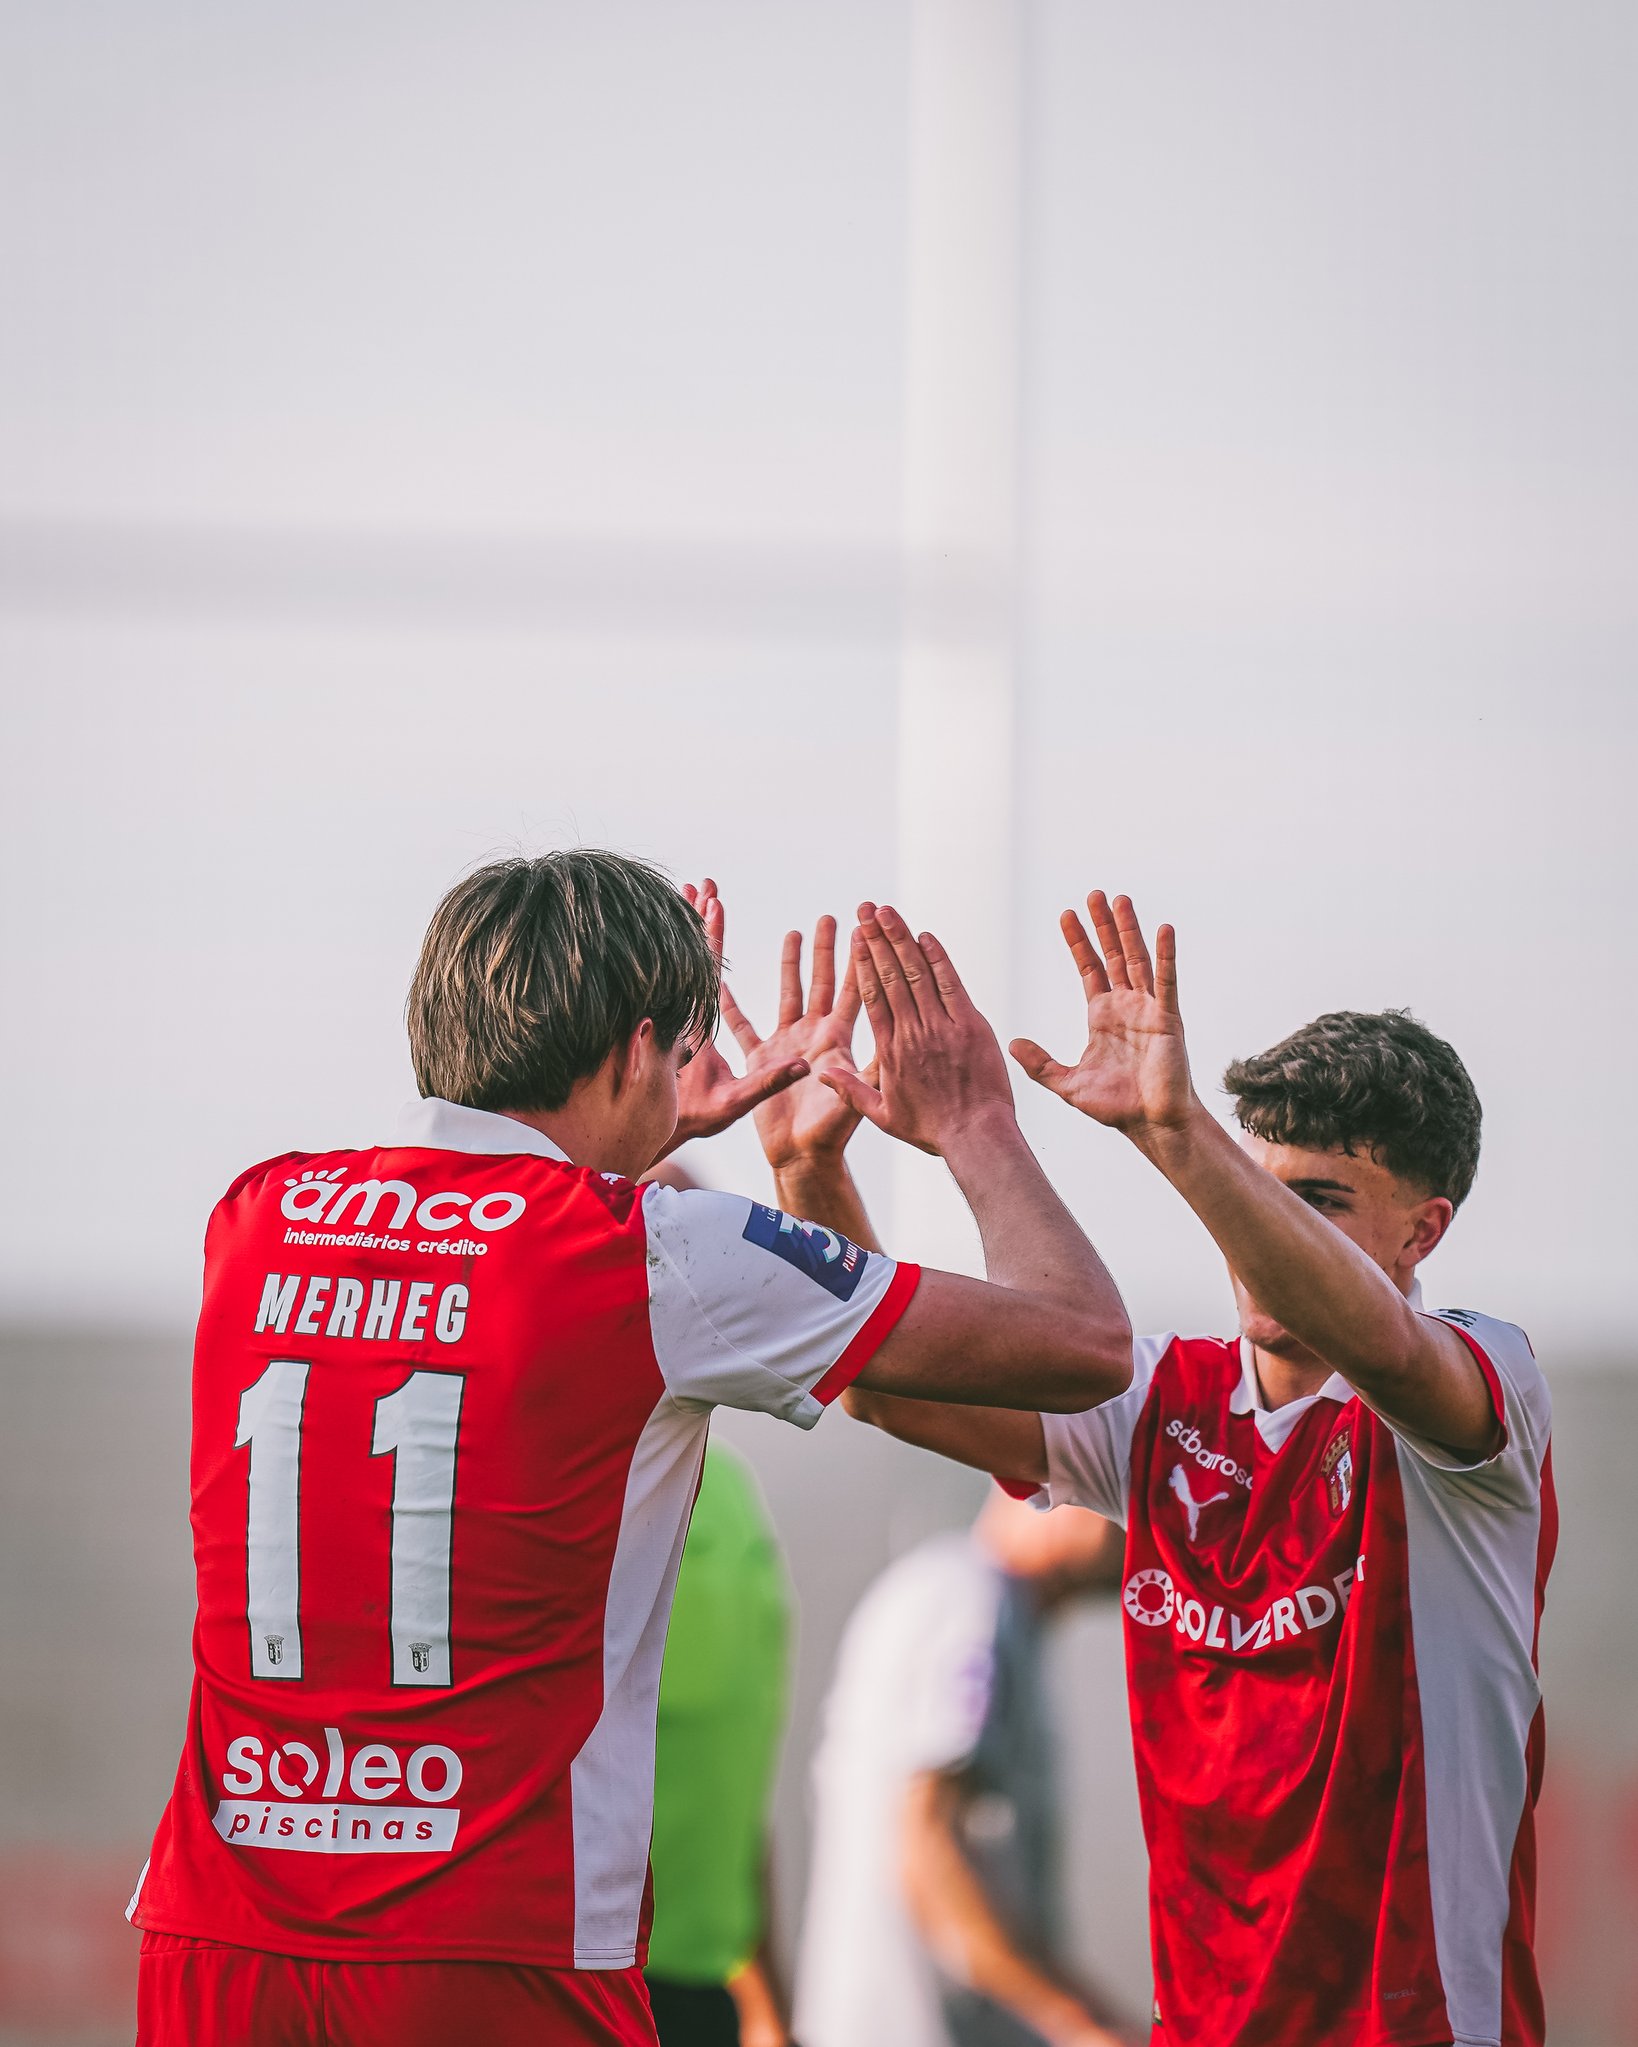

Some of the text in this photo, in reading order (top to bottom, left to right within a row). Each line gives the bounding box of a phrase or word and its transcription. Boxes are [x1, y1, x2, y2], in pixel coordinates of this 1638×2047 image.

[283, 1227, 488, 1256] intermediários crédito
[253, 1272, 472, 1345] MERHEG
[234, 1360, 466, 1689] 11
[222, 1727, 463, 1803] soleo
[227, 1806, 434, 1839] piscinas
